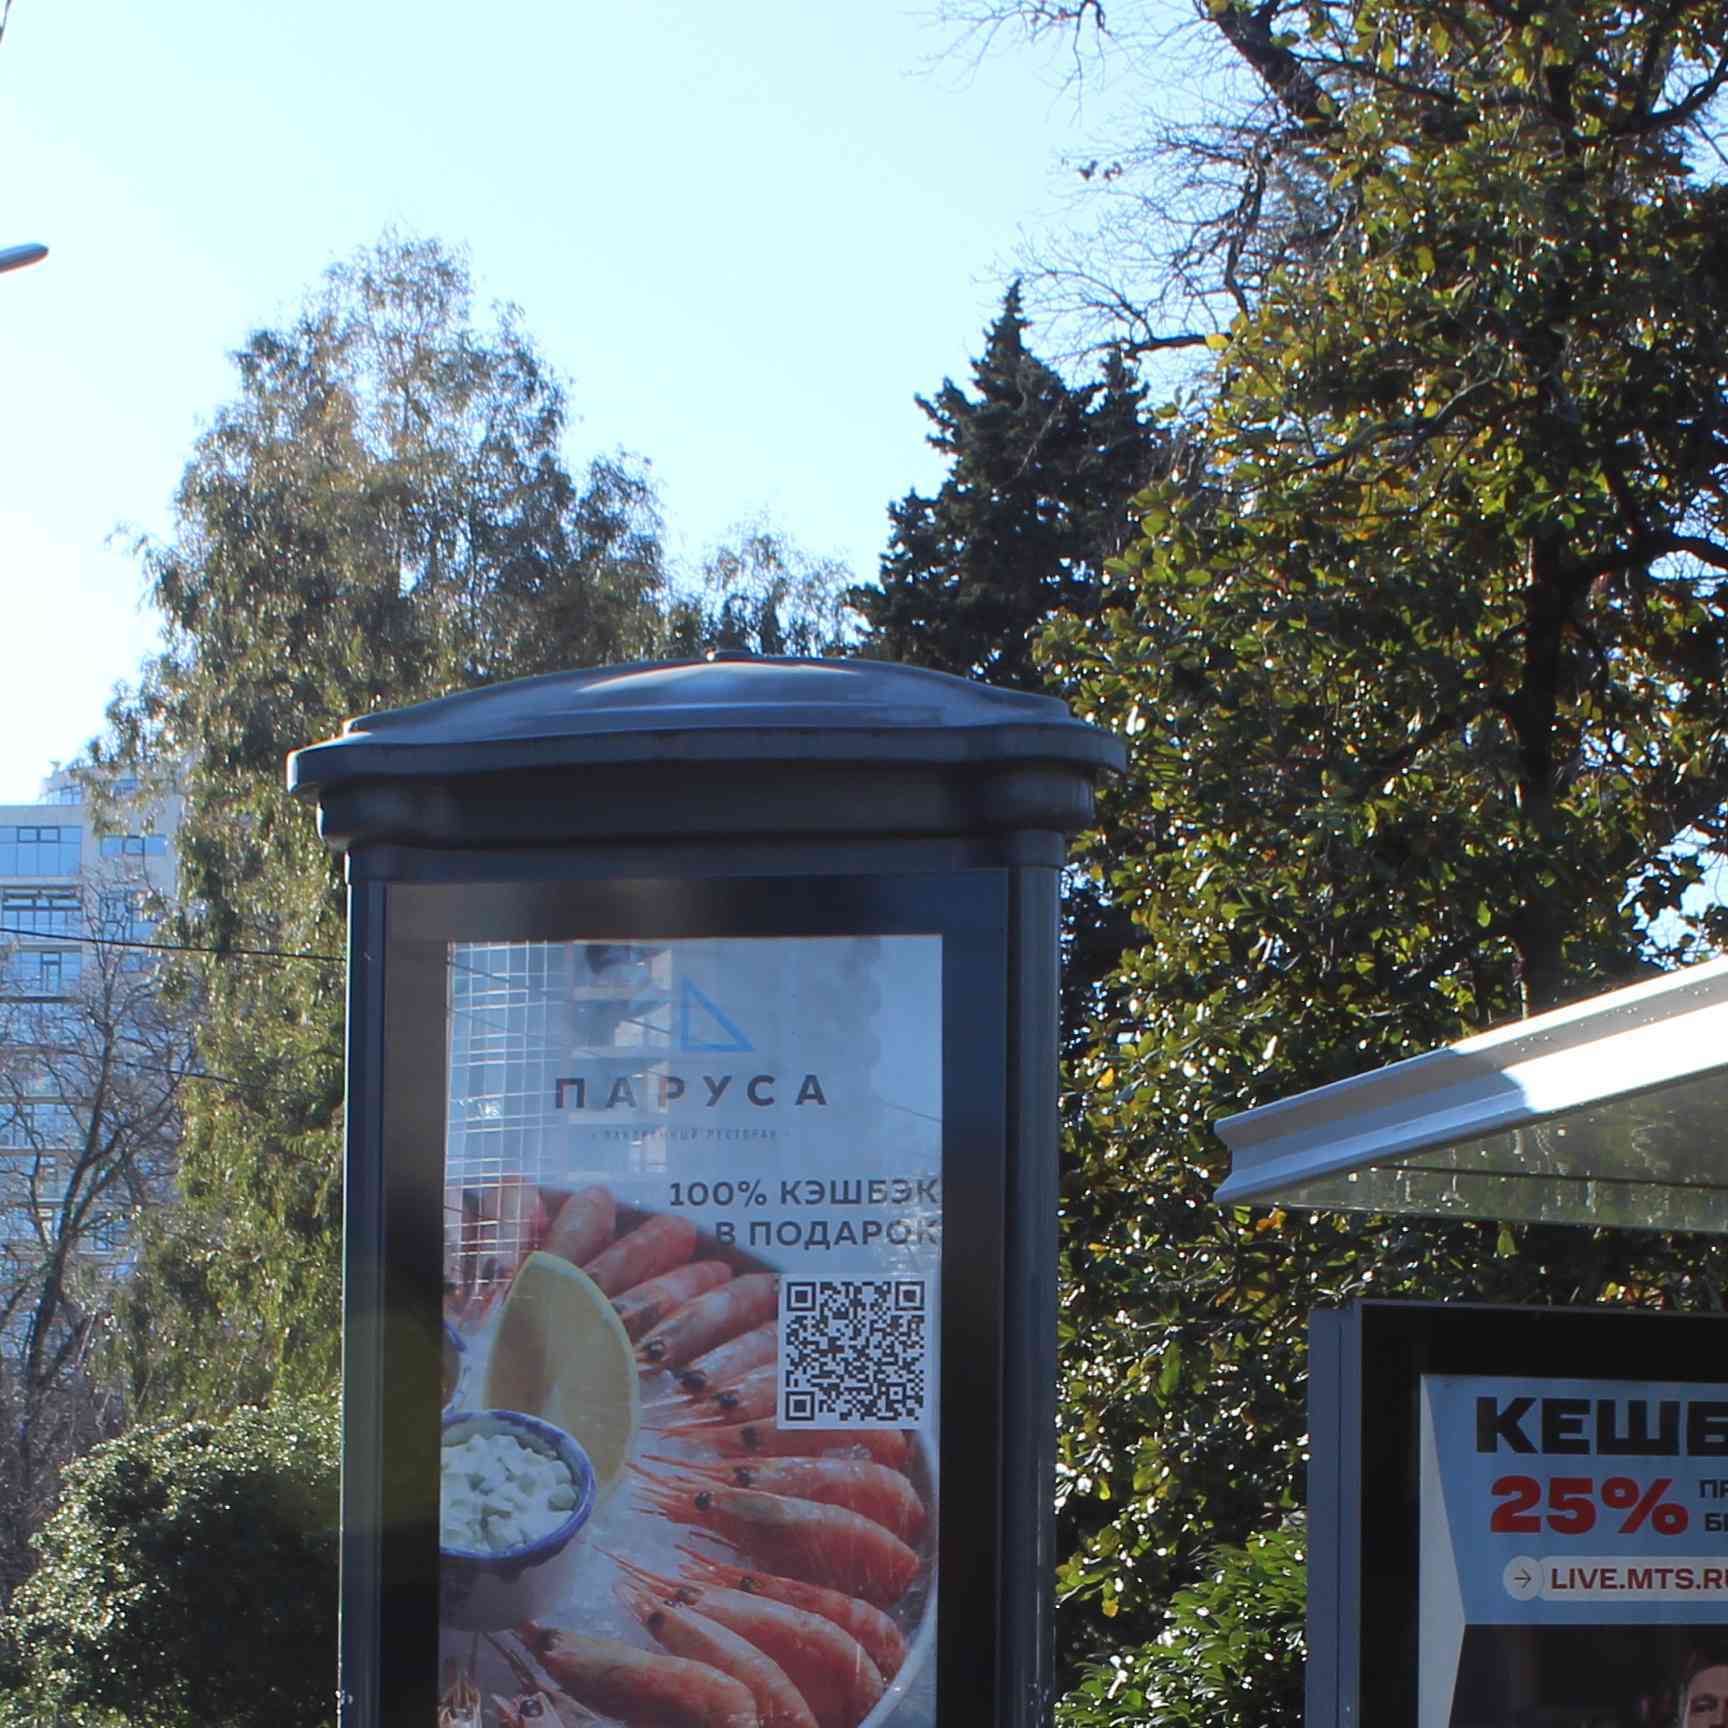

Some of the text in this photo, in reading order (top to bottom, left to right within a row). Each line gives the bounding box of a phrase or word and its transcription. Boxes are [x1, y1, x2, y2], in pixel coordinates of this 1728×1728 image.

[554, 1073, 828, 1109] ПАРУСА
[668, 1178, 940, 1209] 100% КЭШБЭК
[715, 1219, 941, 1251] В ПОДАРОК
[1490, 1475, 1690, 1536] 25%
